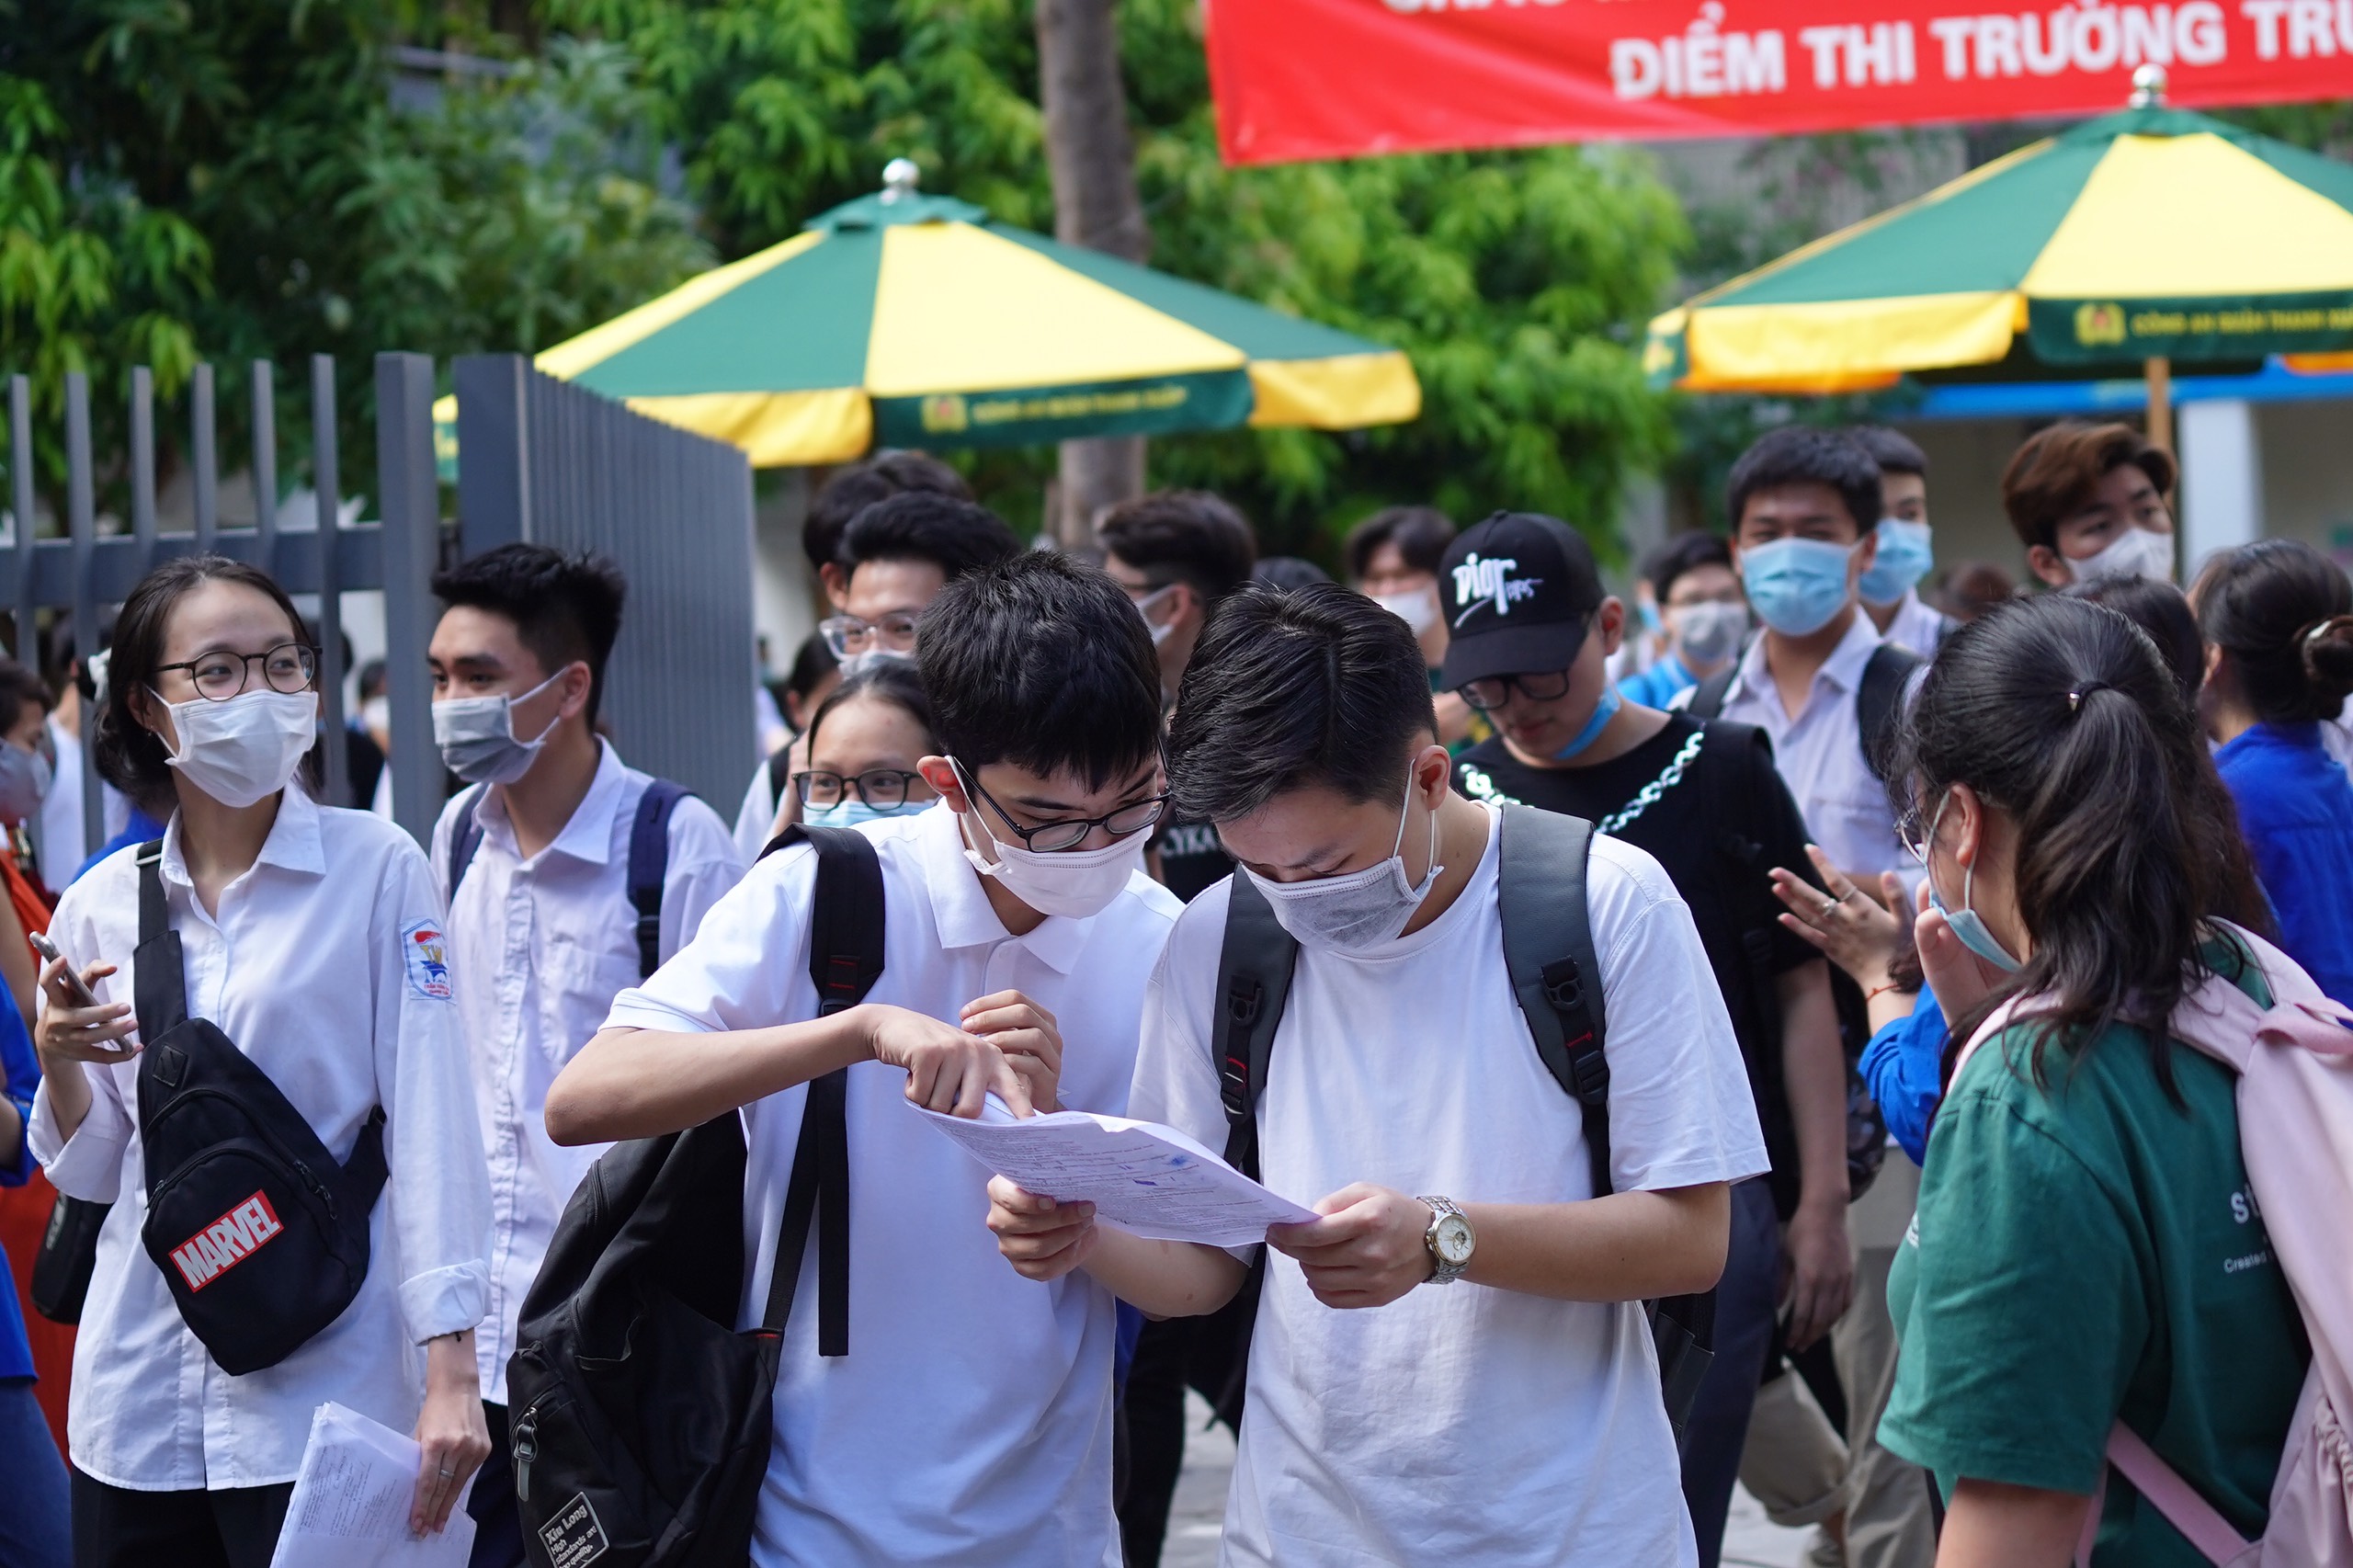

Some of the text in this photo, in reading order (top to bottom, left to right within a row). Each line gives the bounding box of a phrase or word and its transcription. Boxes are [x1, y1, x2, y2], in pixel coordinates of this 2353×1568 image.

[1609, 0, 1786, 99] ĐIỂM
[1799, 20, 1917, 89] THI
[172, 1197, 280, 1289] MARVEL
[545, 1505, 588, 1545] Xiu Long
[551, 1539, 567, 1555] High
[555, 1535, 586, 1565] standards
